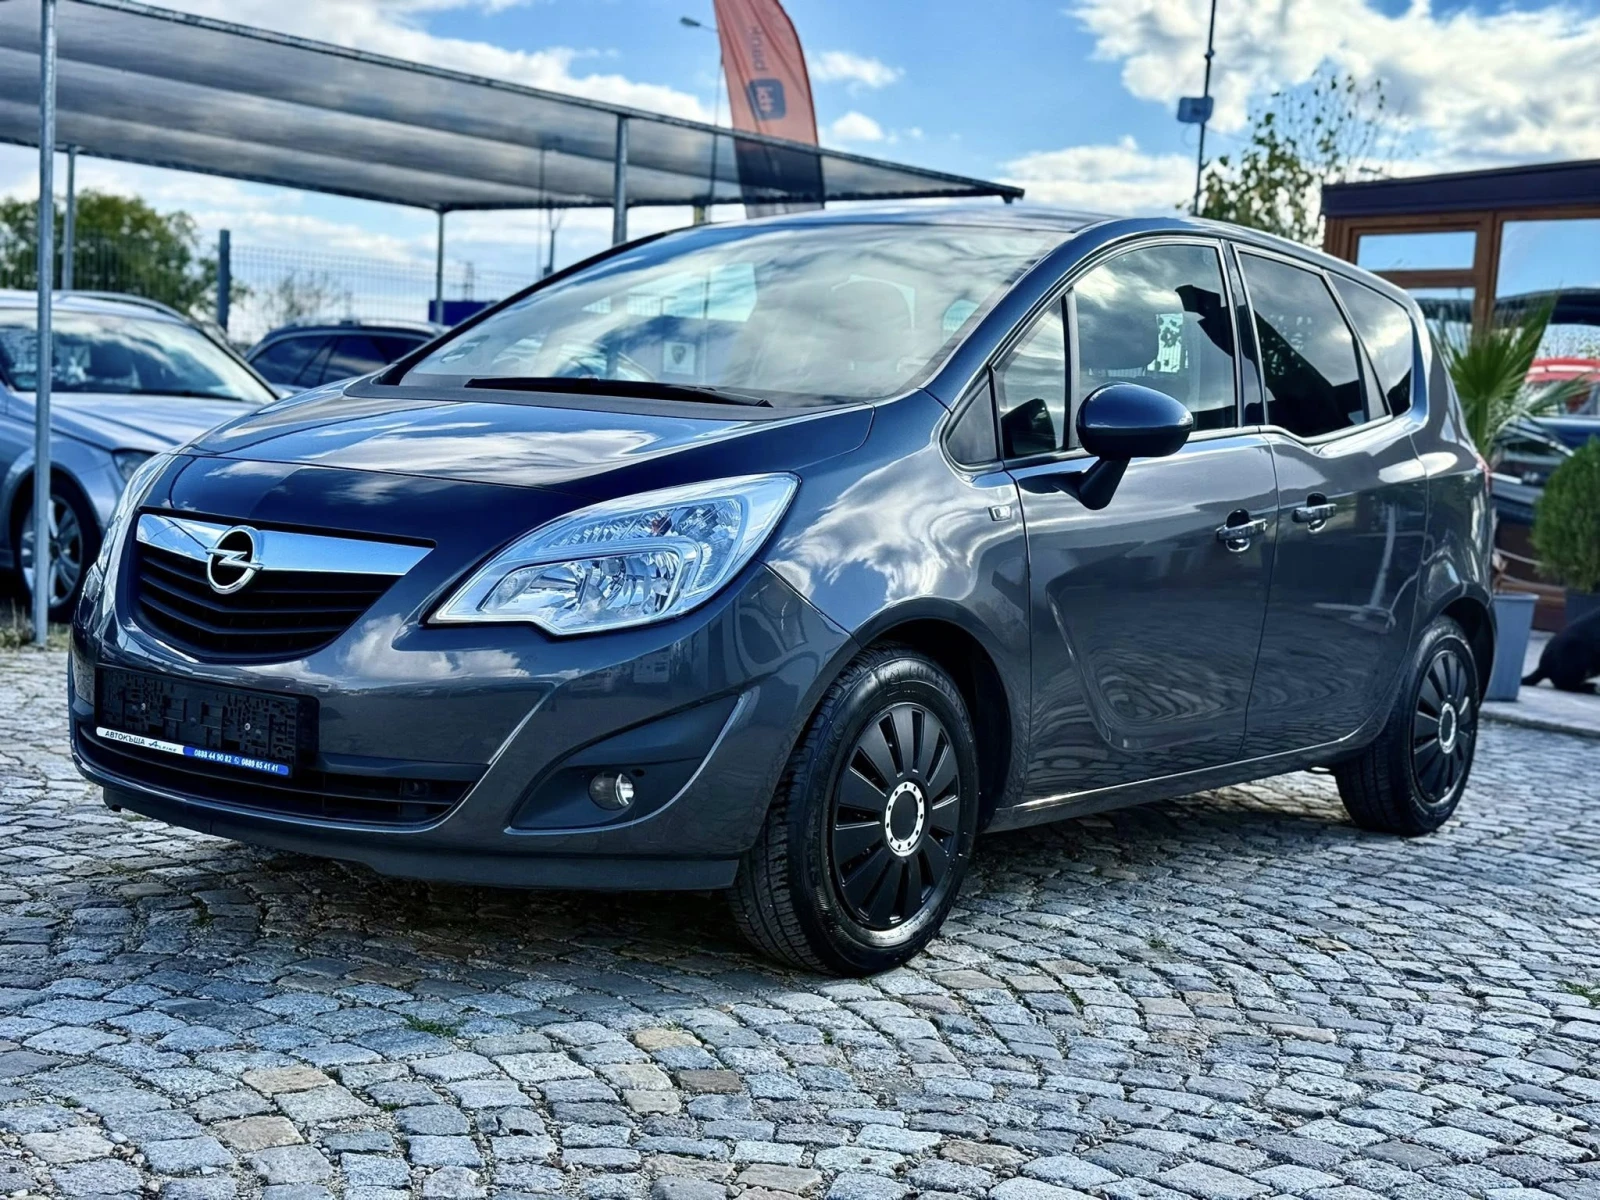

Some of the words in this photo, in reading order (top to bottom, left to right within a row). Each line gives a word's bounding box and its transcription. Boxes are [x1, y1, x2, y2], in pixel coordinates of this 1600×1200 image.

[208, 751, 216, 760] 44
[216, 753, 224, 762] 90
[224, 755, 232, 763] 82
[255, 761, 263, 769] 65
[263, 762, 271, 771] 41
[271, 764, 279, 772] 41
